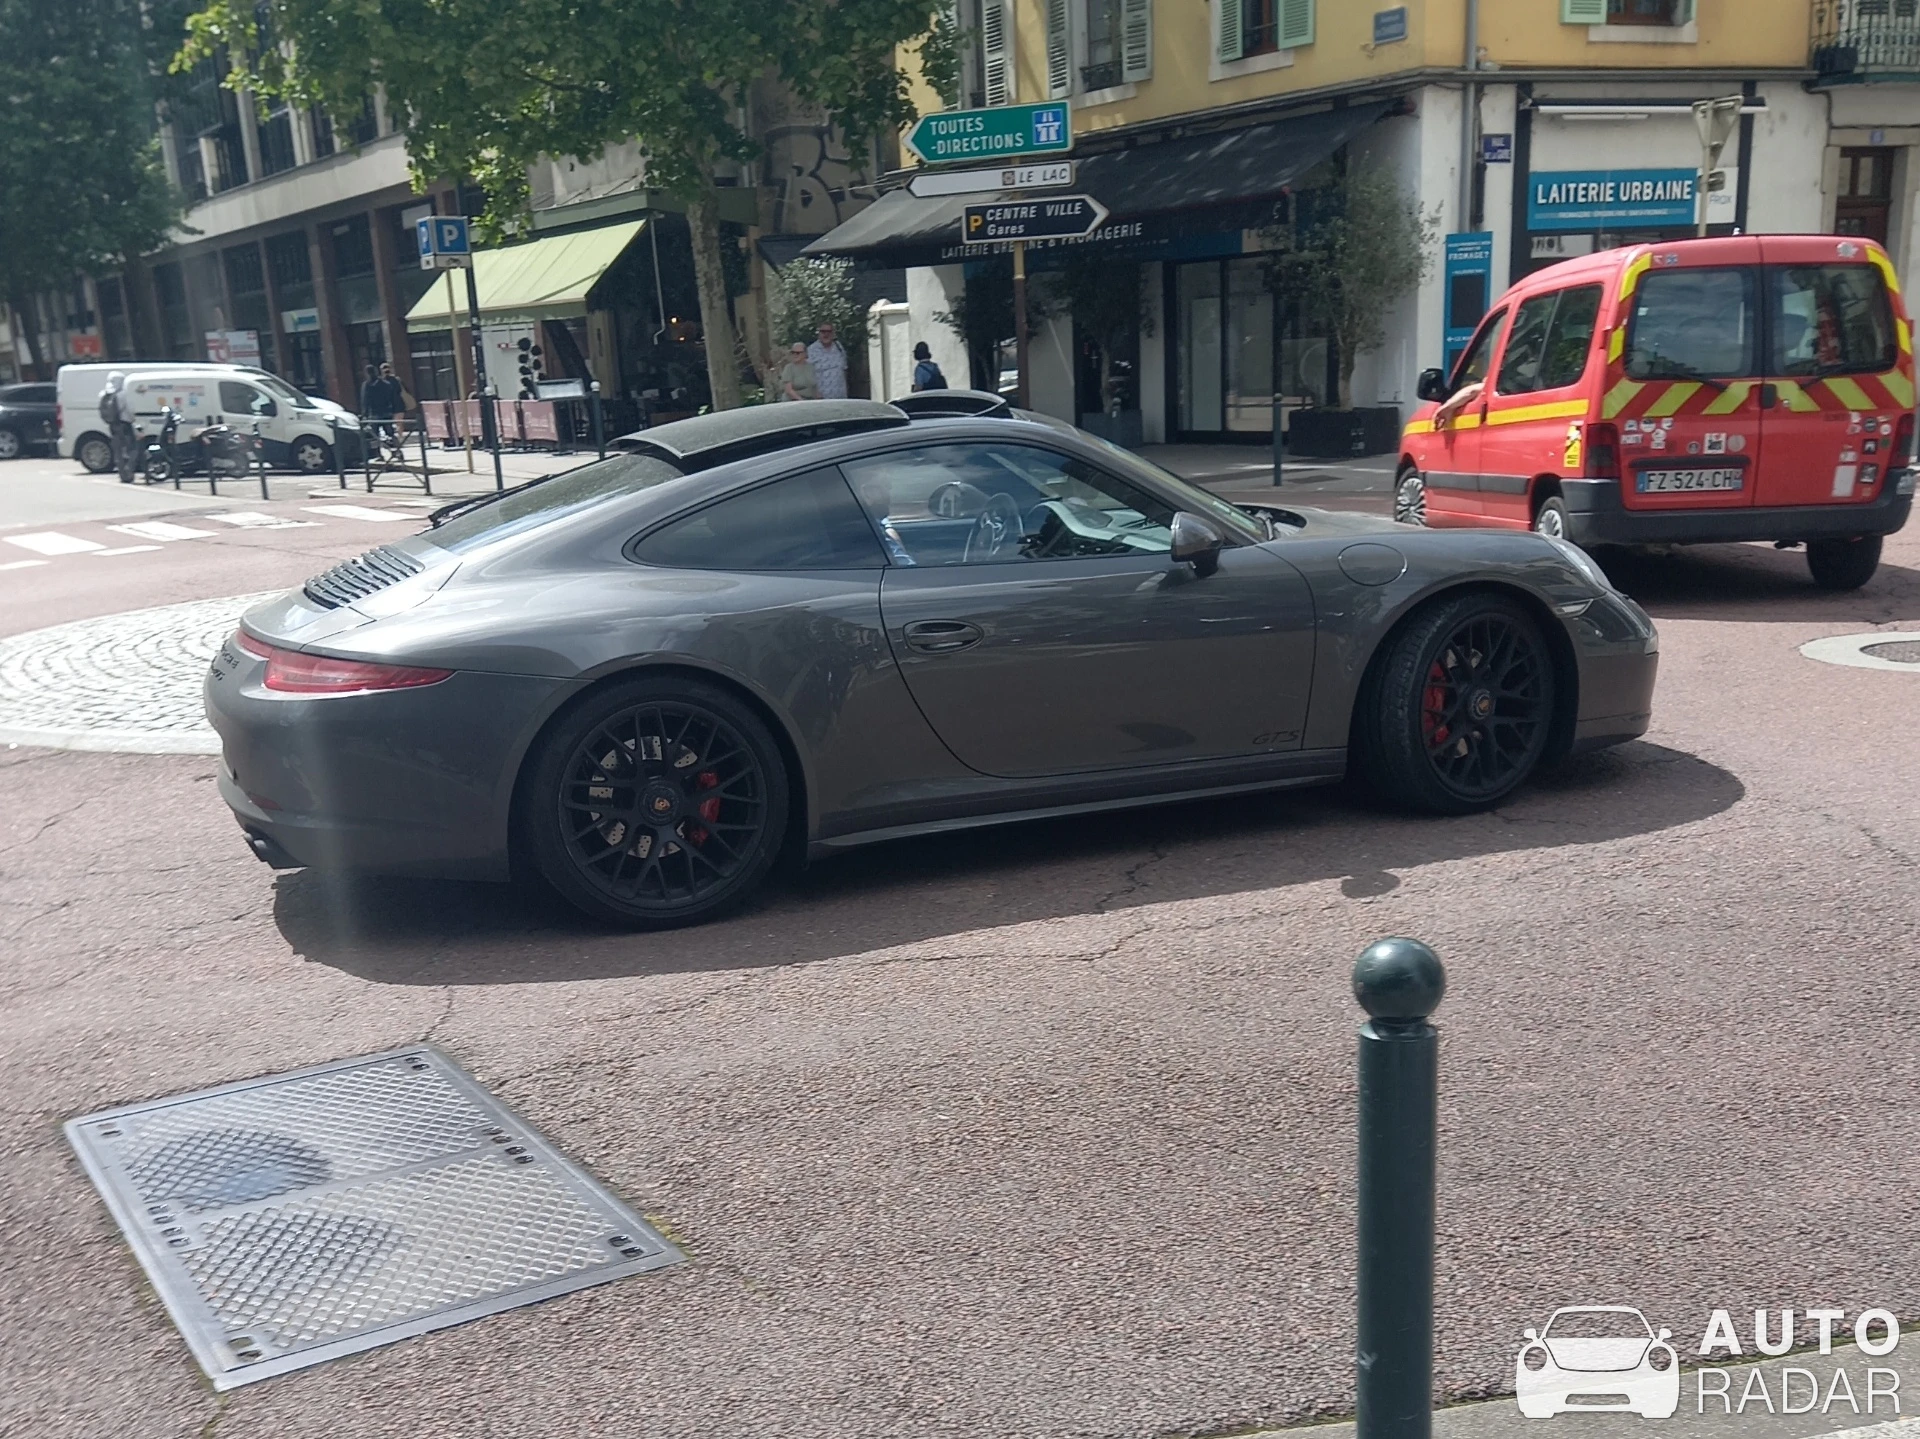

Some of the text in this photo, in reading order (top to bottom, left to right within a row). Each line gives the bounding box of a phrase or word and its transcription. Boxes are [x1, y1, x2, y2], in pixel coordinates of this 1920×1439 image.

[929, 117, 984, 135] TOUTES
[1019, 168, 1068, 183] LE LAC
[1537, 180, 1693, 204] LAITERIE URBAINE
[985, 202, 1083, 221] CENTRE VILLE
[969, 215, 983, 232] P
[987, 224, 1025, 236] Gares
[442, 224, 459, 247] P
[941, 243, 989, 259] LAITERIE
[1252, 730, 1300, 745] GTS
